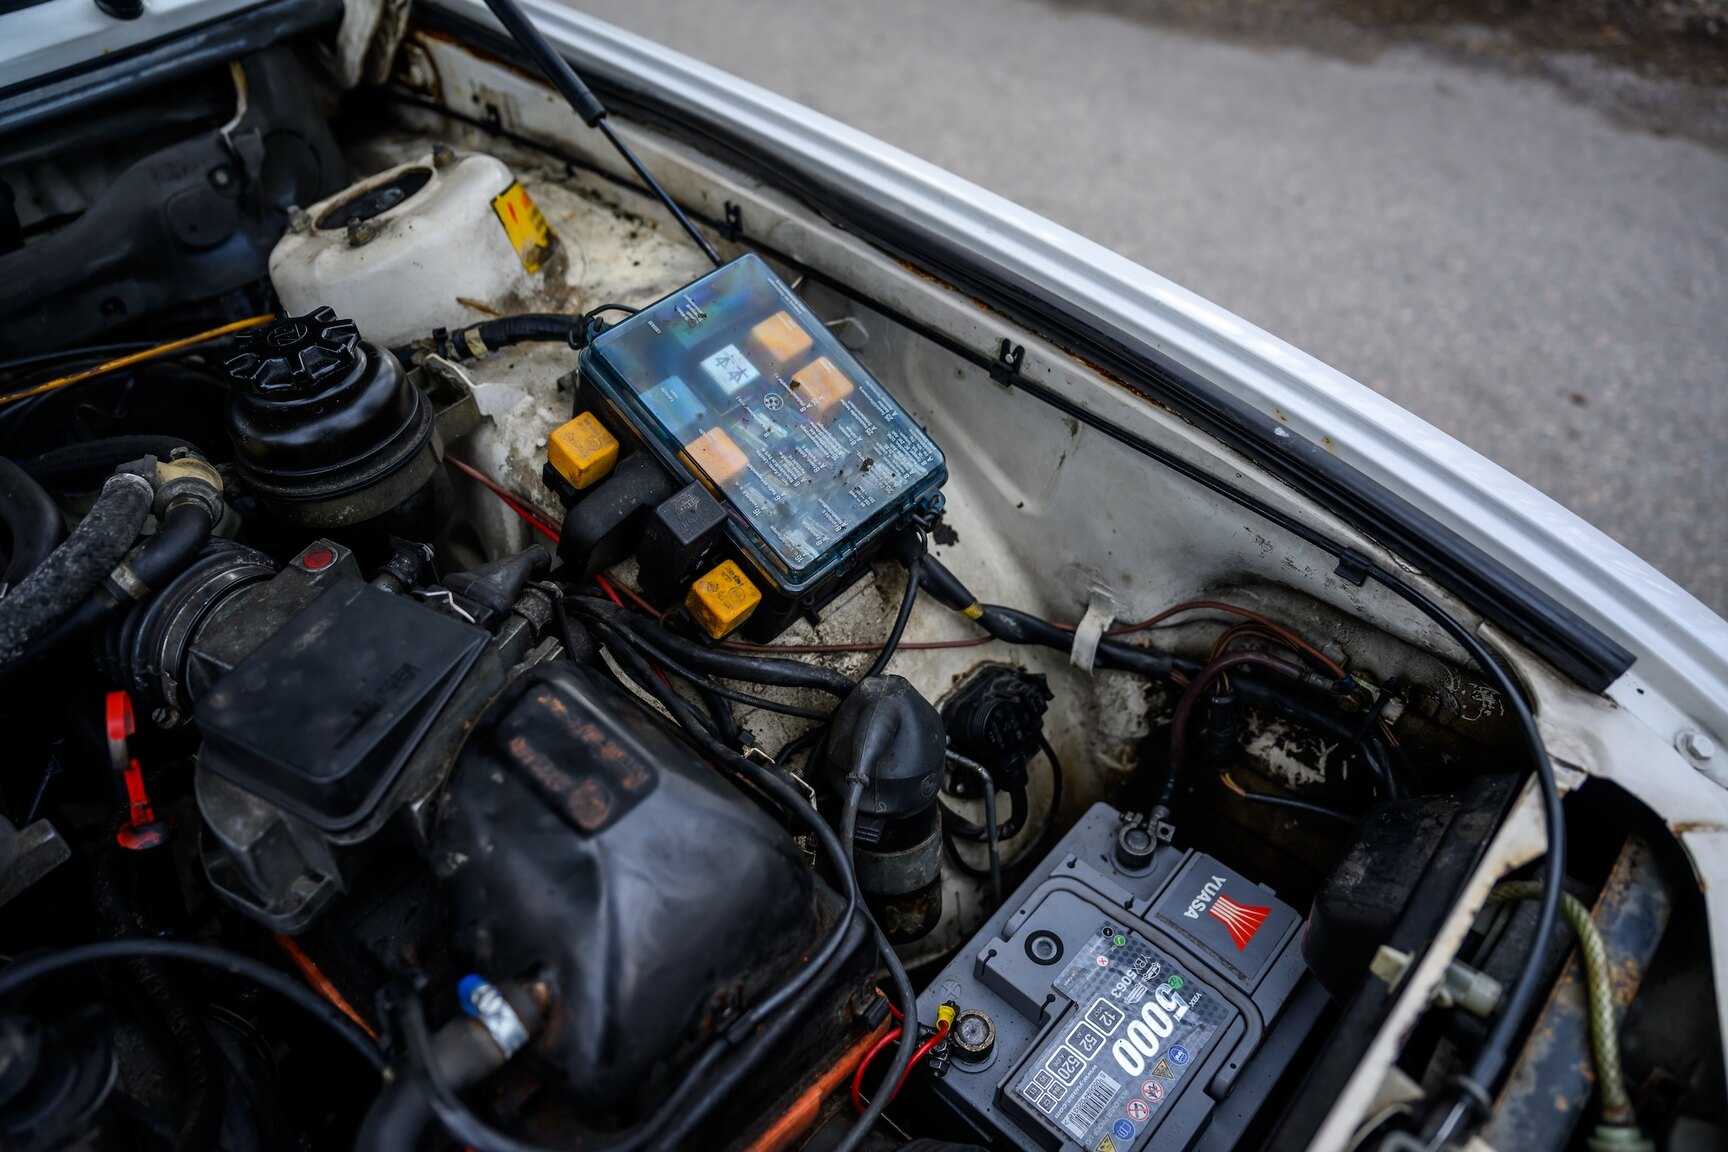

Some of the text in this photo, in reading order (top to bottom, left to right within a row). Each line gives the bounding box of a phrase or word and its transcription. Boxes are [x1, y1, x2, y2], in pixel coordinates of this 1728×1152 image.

[1182, 873, 1226, 921] YUASA
[1109, 952, 1149, 999] YBX5063
[1188, 992, 1201, 1007] YBX
[1098, 1009, 1116, 1027] 12
[1109, 982, 1190, 1077] 5000
[1078, 1032, 1097, 1052] 52
[1056, 1054, 1080, 1080] 520
[1053, 1064, 1097, 1118] www.yuasa.com
[1105, 1089, 1128, 1116] ROLLOVER
[1092, 1116, 1108, 1136] PROOF
